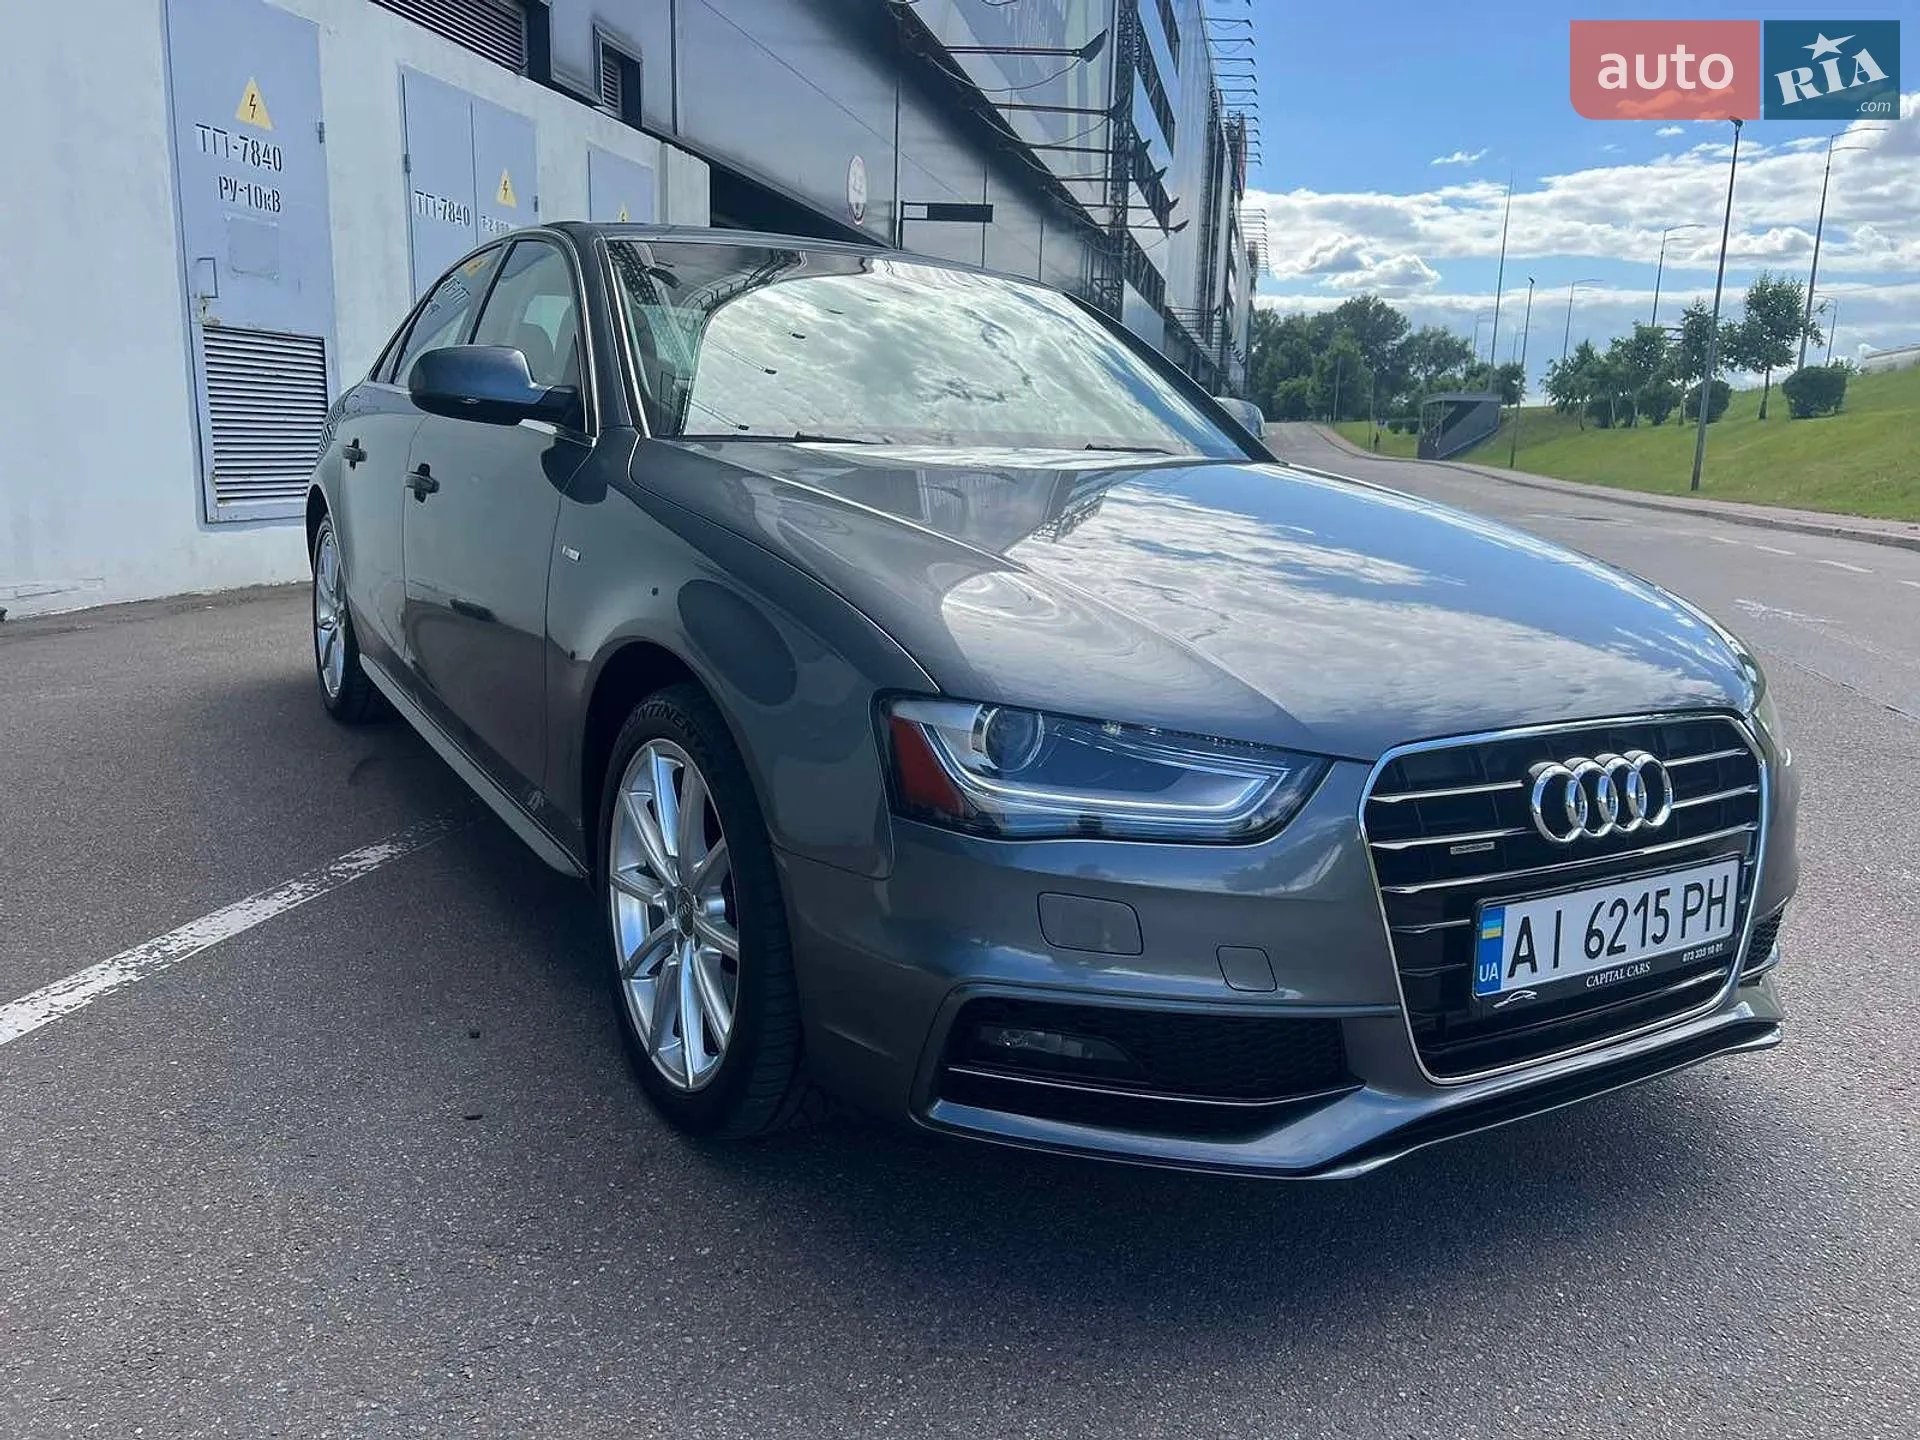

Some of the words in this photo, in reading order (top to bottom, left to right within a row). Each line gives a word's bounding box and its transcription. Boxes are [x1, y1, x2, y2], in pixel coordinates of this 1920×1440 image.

[1507, 909, 1562, 979] AI
[1583, 887, 1670, 960] 6215
[1680, 875, 1729, 939] PH
[1479, 961, 1499, 983] UA
[1586, 965, 1626, 988] CAPITAL
[1627, 961, 1650, 978] CARS
